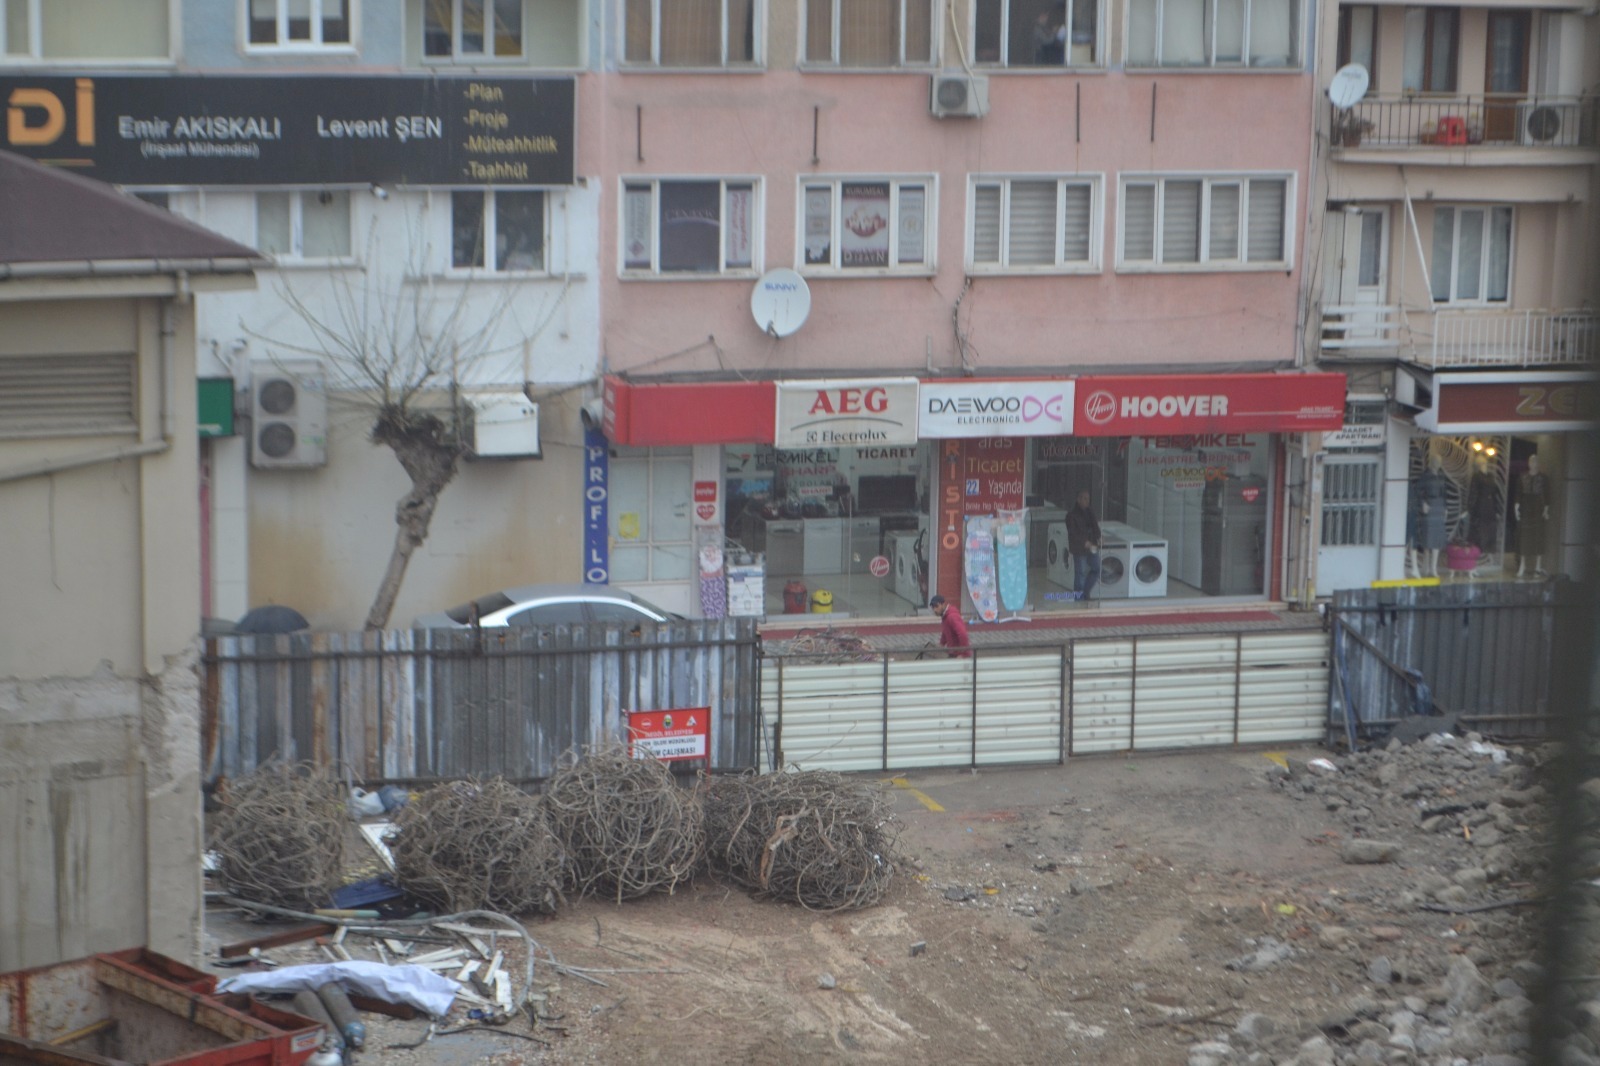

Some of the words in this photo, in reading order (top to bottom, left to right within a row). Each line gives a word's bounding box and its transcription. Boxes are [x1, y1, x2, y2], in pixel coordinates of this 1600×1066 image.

[118, 116, 170, 139] Emir
[316, 115, 390, 139] Levent
[394, 116, 443, 143] ŞEN
[808, 387, 889, 416] AEG
[929, 396, 1021, 414] DAEWOO
[1120, 394, 1229, 418] HOOVER
[822, 428, 888, 442] Electrolux
[967, 456, 1022, 474] Ticaret
[988, 479, 1022, 498] Yaşında
